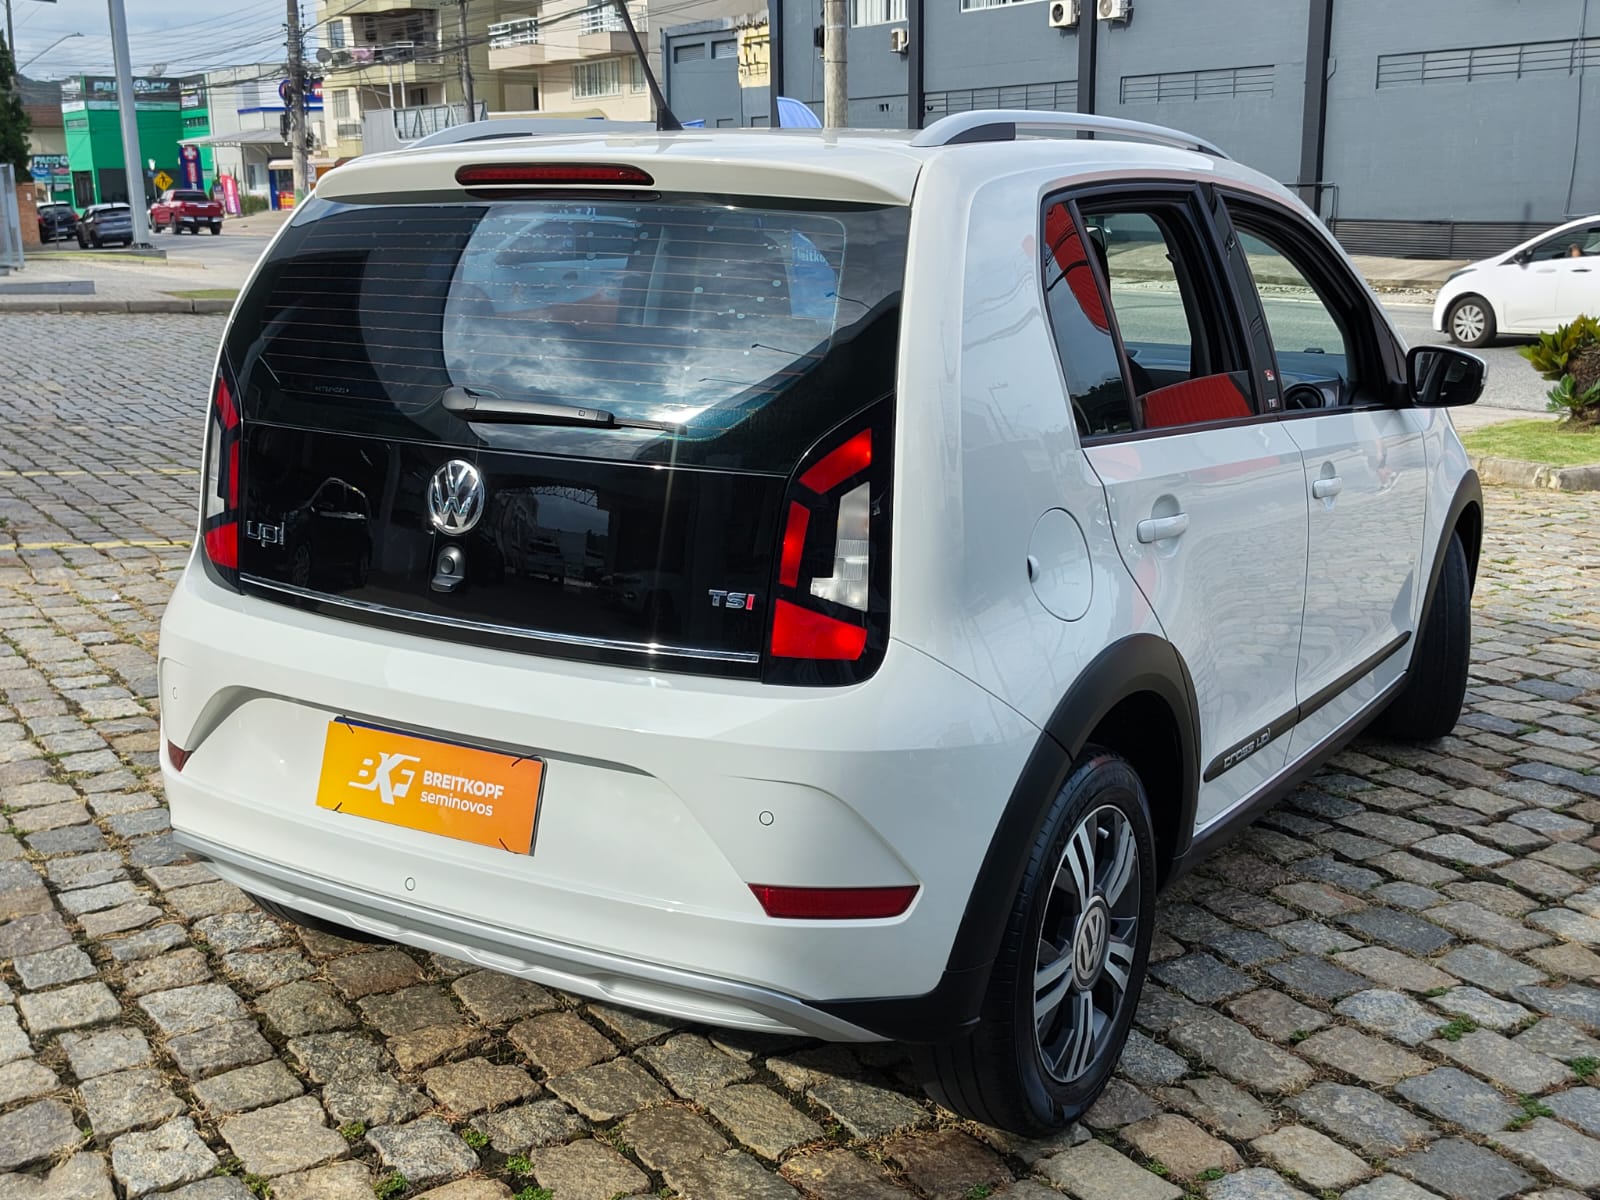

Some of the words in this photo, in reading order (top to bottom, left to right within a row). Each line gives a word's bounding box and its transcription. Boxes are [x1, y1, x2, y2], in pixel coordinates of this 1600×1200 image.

[708, 589, 756, 611] TSI
[423, 770, 505, 799] BREITKOPF
[420, 791, 493, 817] seminovos
